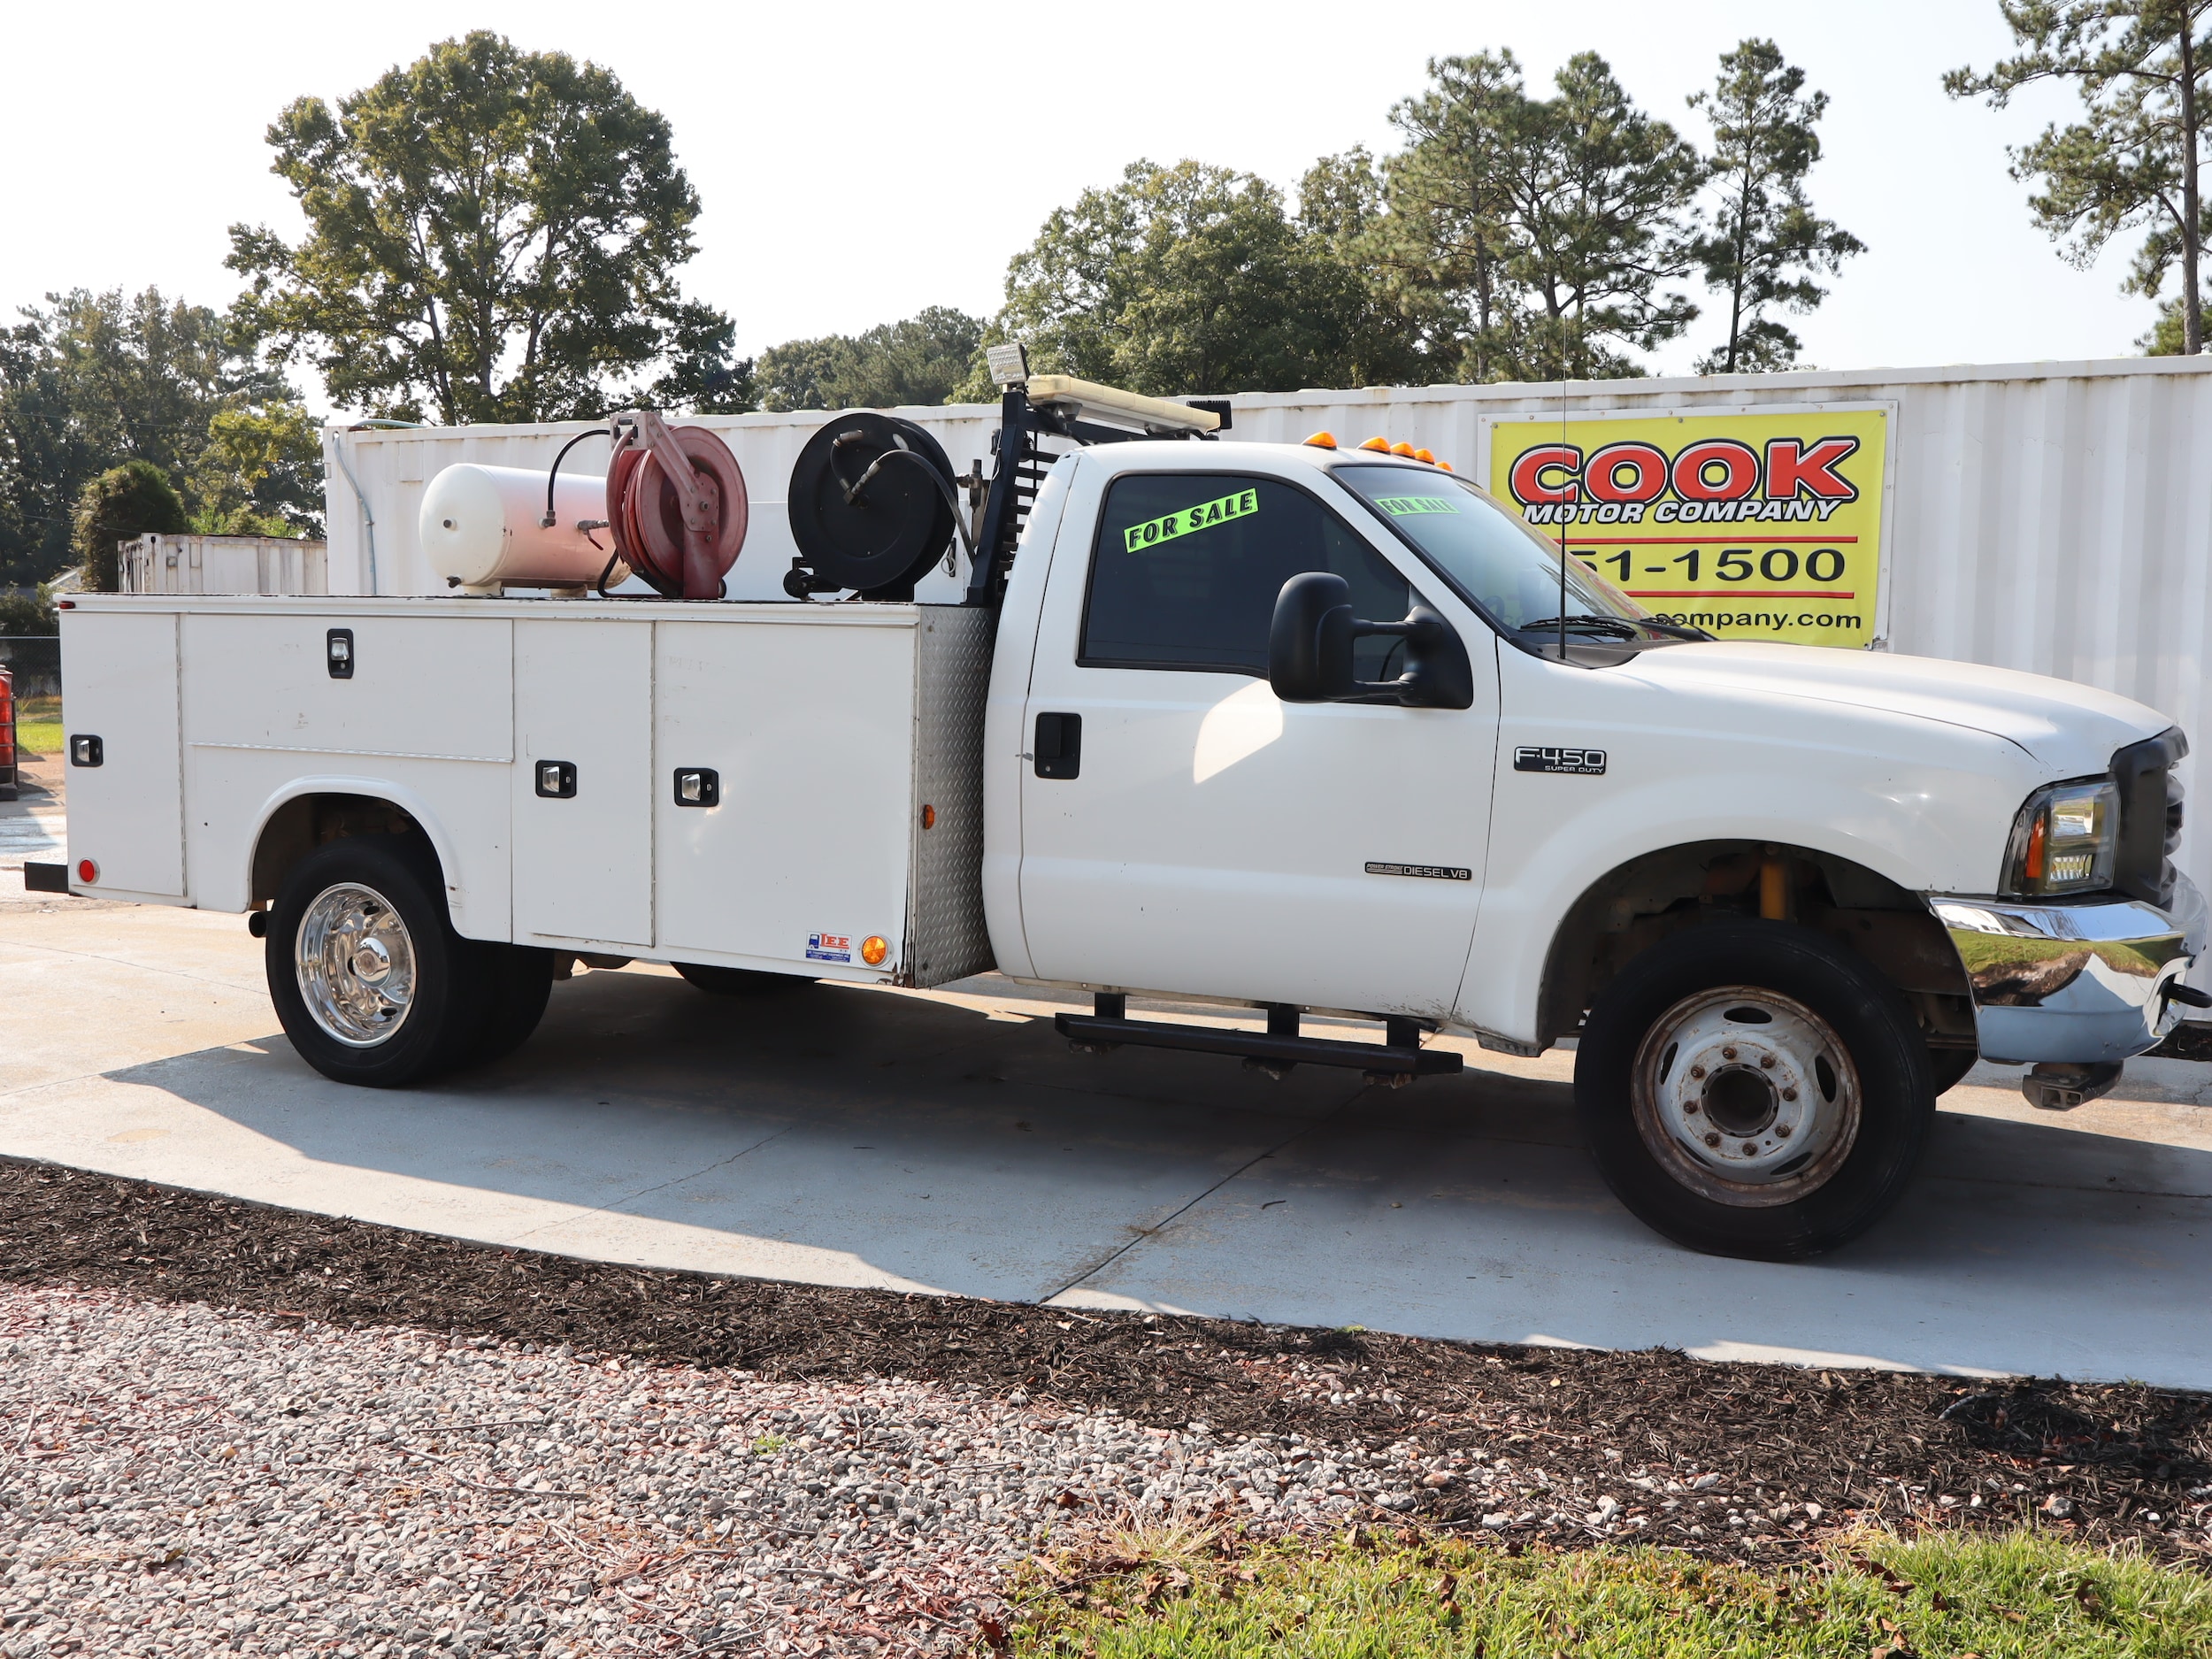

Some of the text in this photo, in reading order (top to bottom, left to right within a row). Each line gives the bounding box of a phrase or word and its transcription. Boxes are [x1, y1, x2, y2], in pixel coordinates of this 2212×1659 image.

[1509, 435, 1860, 505] COOK
[1380, 498, 1457, 514] FOR SALE
[1524, 500, 1845, 525] MOTOR COMPANY
[1129, 492, 1253, 549] FOR SALE
[1403, 866, 1468, 879] DIESEL V8
[820, 933, 849, 949] LEE
